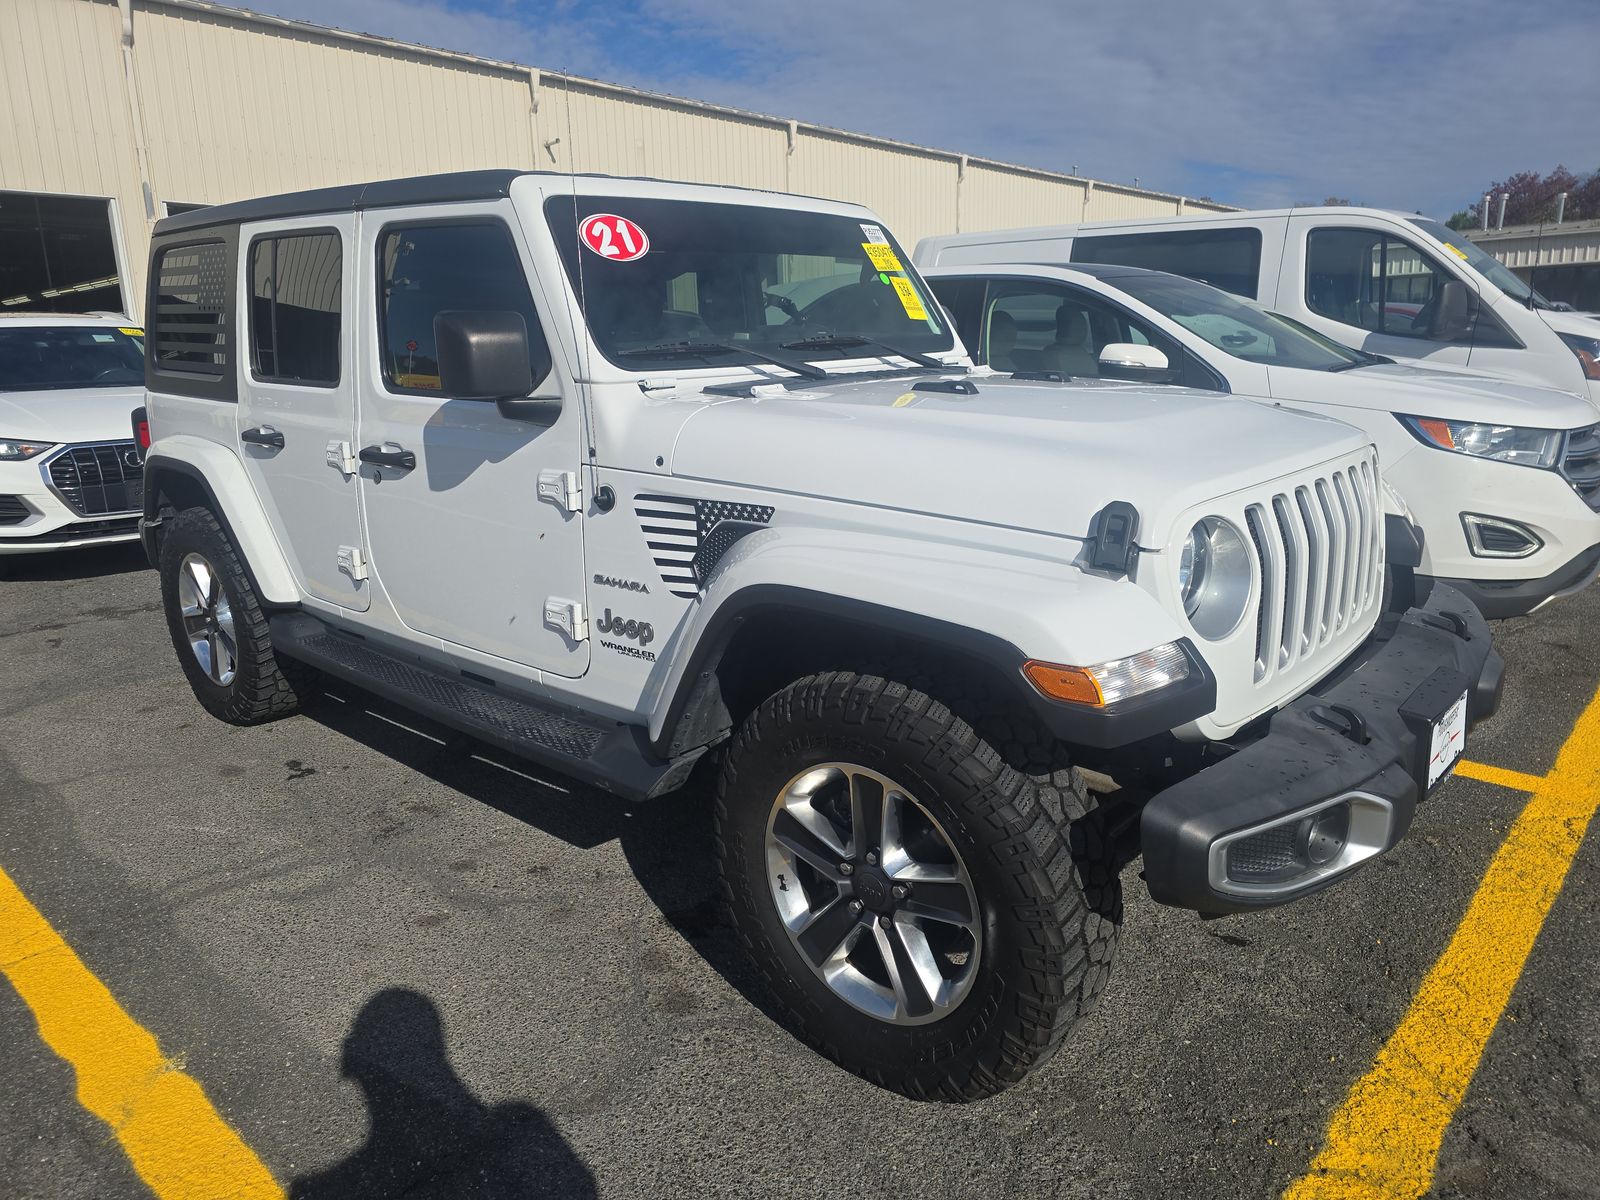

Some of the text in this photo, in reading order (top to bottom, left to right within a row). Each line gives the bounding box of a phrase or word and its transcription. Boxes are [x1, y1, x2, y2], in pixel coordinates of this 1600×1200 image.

[592, 221, 636, 255] 21
[593, 574, 651, 594] SAHARA
[597, 607, 653, 645] Jeep
[600, 640, 655, 658] WRANGLER
[618, 651, 656, 662] UNLIMITED
